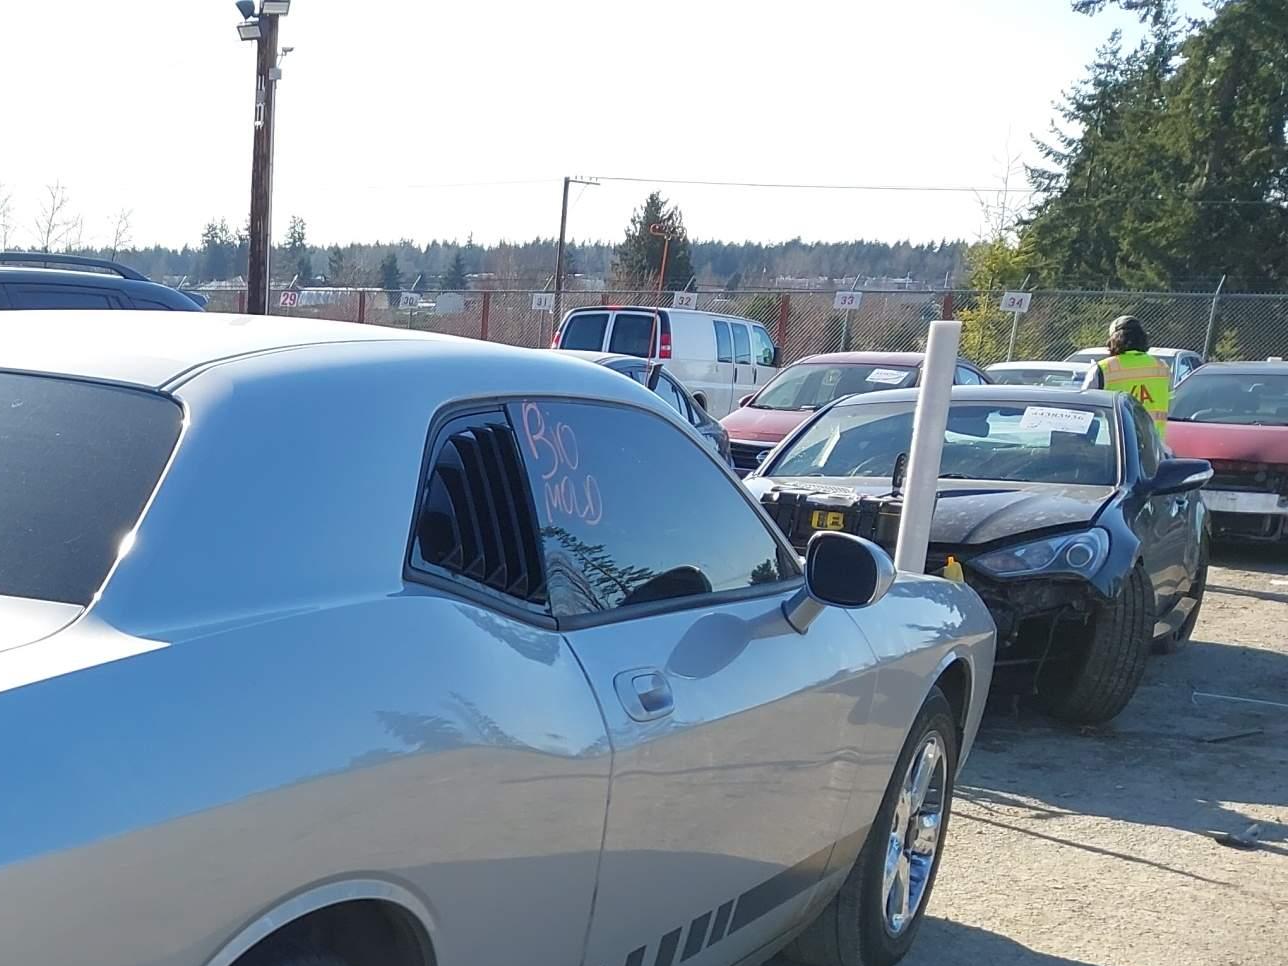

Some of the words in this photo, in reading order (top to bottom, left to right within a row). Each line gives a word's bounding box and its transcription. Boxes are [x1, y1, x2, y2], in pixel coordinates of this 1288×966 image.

[281, 292, 297, 306] 29
[536, 295, 548, 306] 31
[678, 296, 692, 306] 32
[840, 295, 855, 306] 33
[1007, 297, 1023, 308] 34
